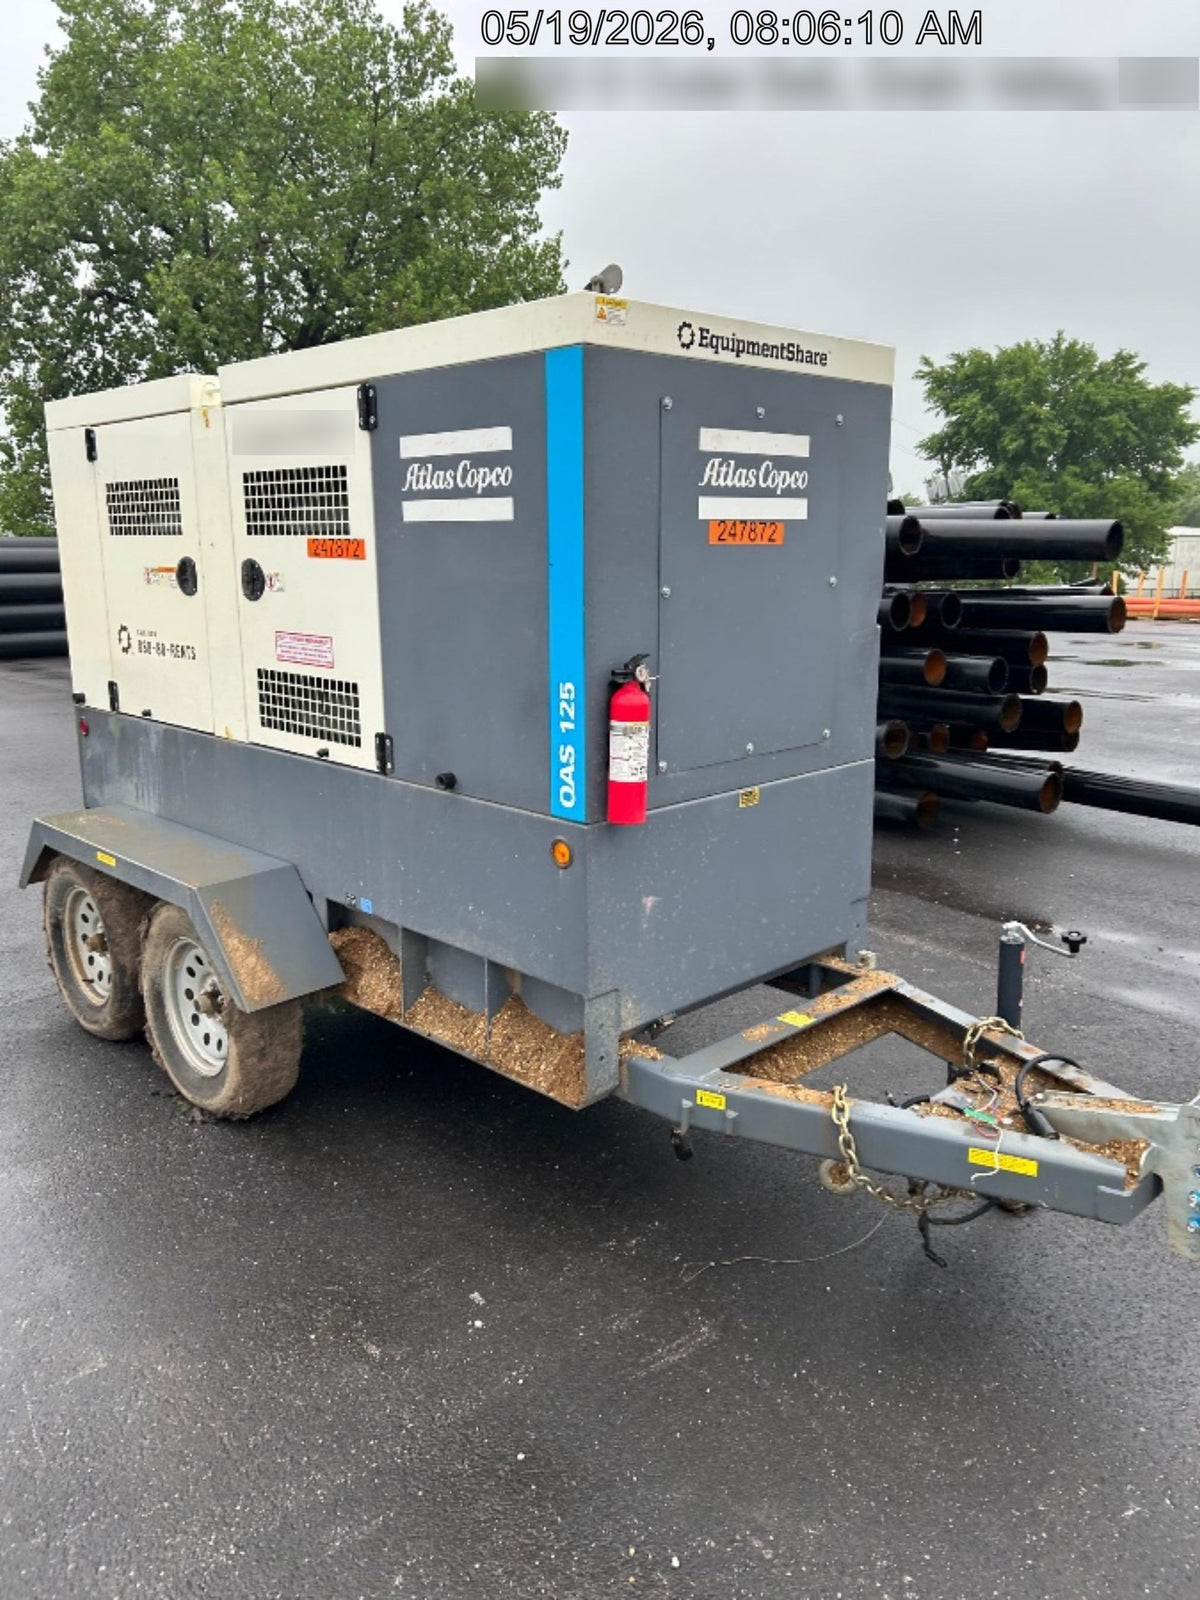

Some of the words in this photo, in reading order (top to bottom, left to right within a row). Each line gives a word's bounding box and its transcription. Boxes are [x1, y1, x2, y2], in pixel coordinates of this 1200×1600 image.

[698, 327, 829, 367] EquipmentShare
[401, 463, 455, 492] Atlas
[456, 459, 513, 495] Copco
[698, 458, 757, 488] Atlas
[758, 460, 808, 495] Copco
[312, 538, 360, 558] 247872
[716, 520, 778, 543] 247872
[559, 682, 576, 733] 125
